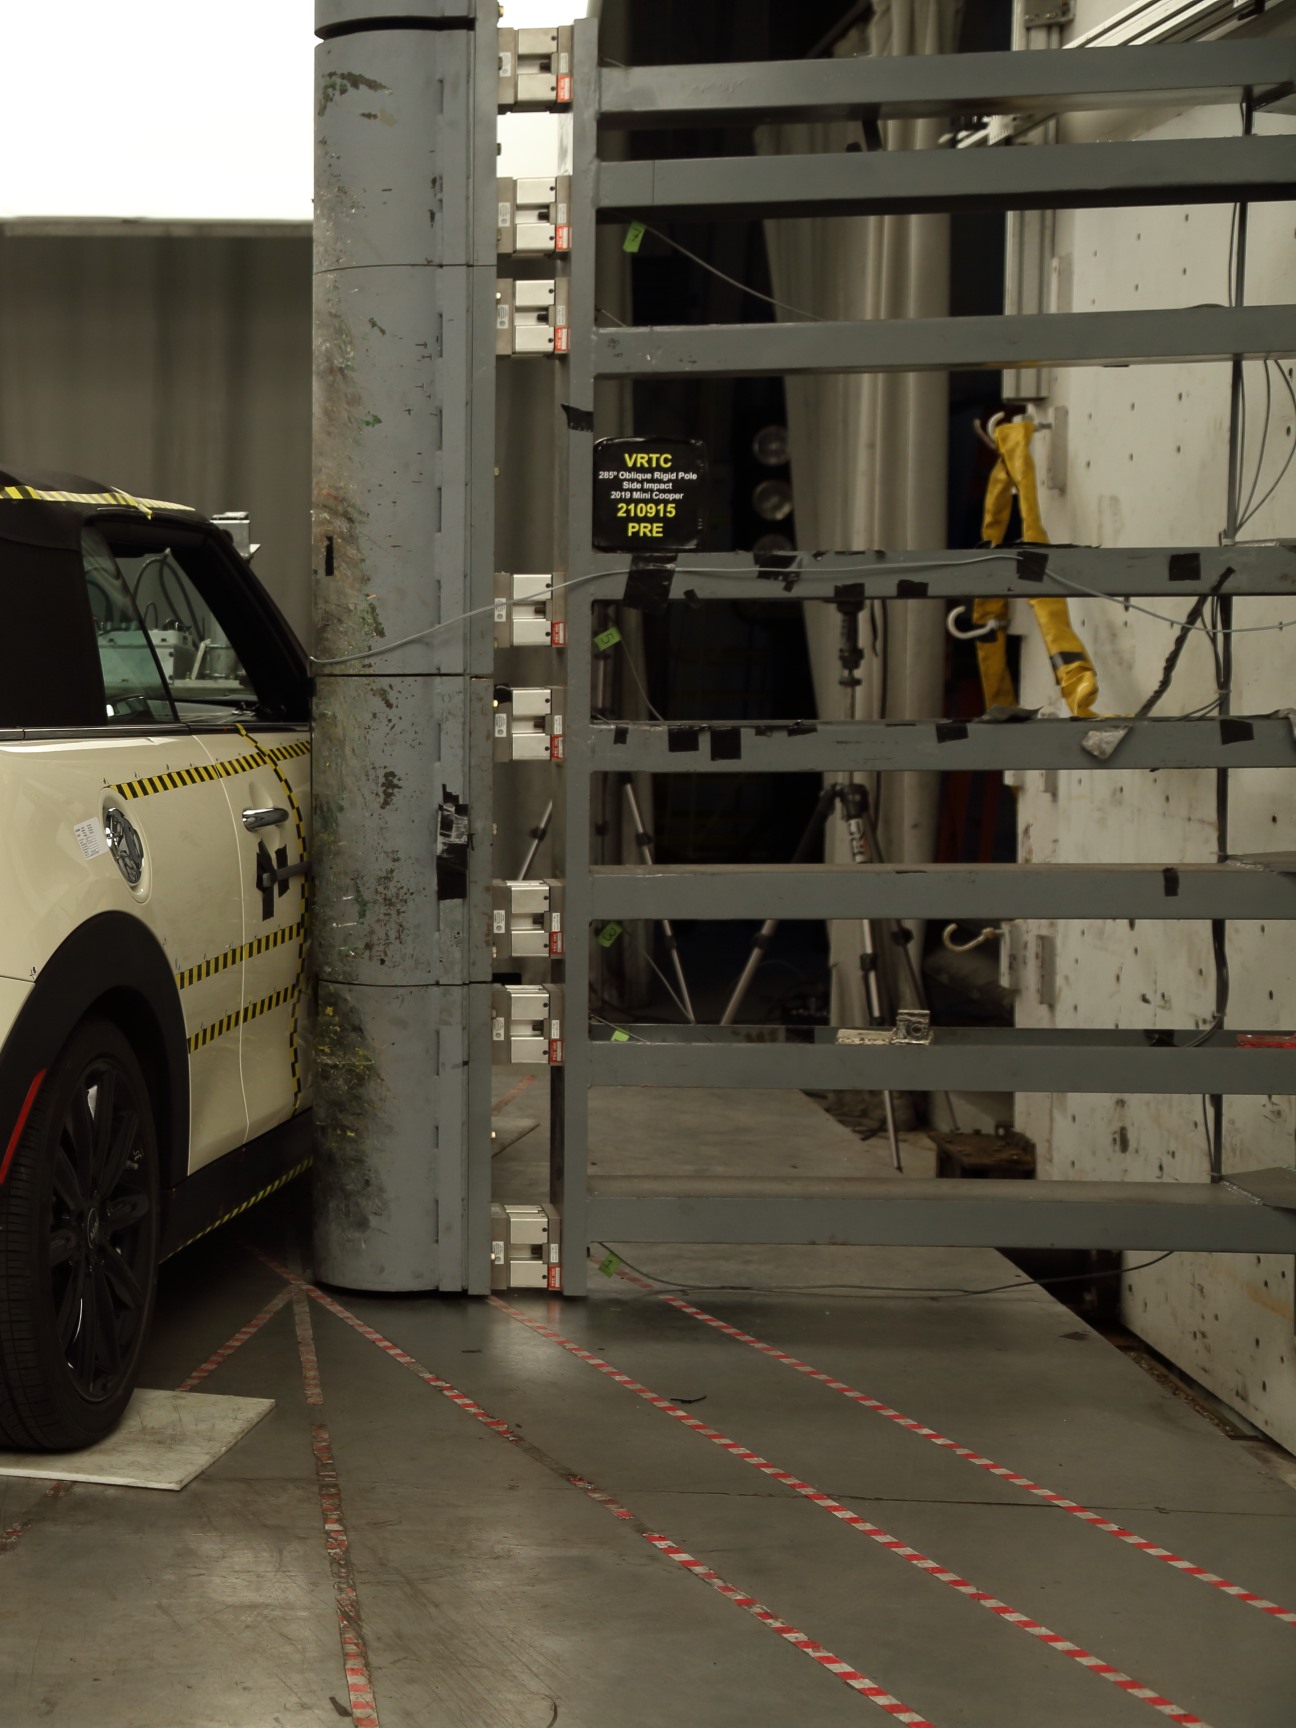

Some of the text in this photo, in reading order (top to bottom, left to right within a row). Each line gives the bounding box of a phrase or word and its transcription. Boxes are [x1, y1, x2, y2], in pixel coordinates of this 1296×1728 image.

[624, 453, 672, 468] VRTC
[619, 471, 652, 481] Oblique
[654, 471, 677, 481] Rigid
[678, 472, 698, 480] Pole
[622, 481, 672, 490] Side Impact
[610, 491, 684, 501] 2019 Mini Cooper
[616, 503, 676, 518] 210915
[627, 523, 664, 537] PRE
